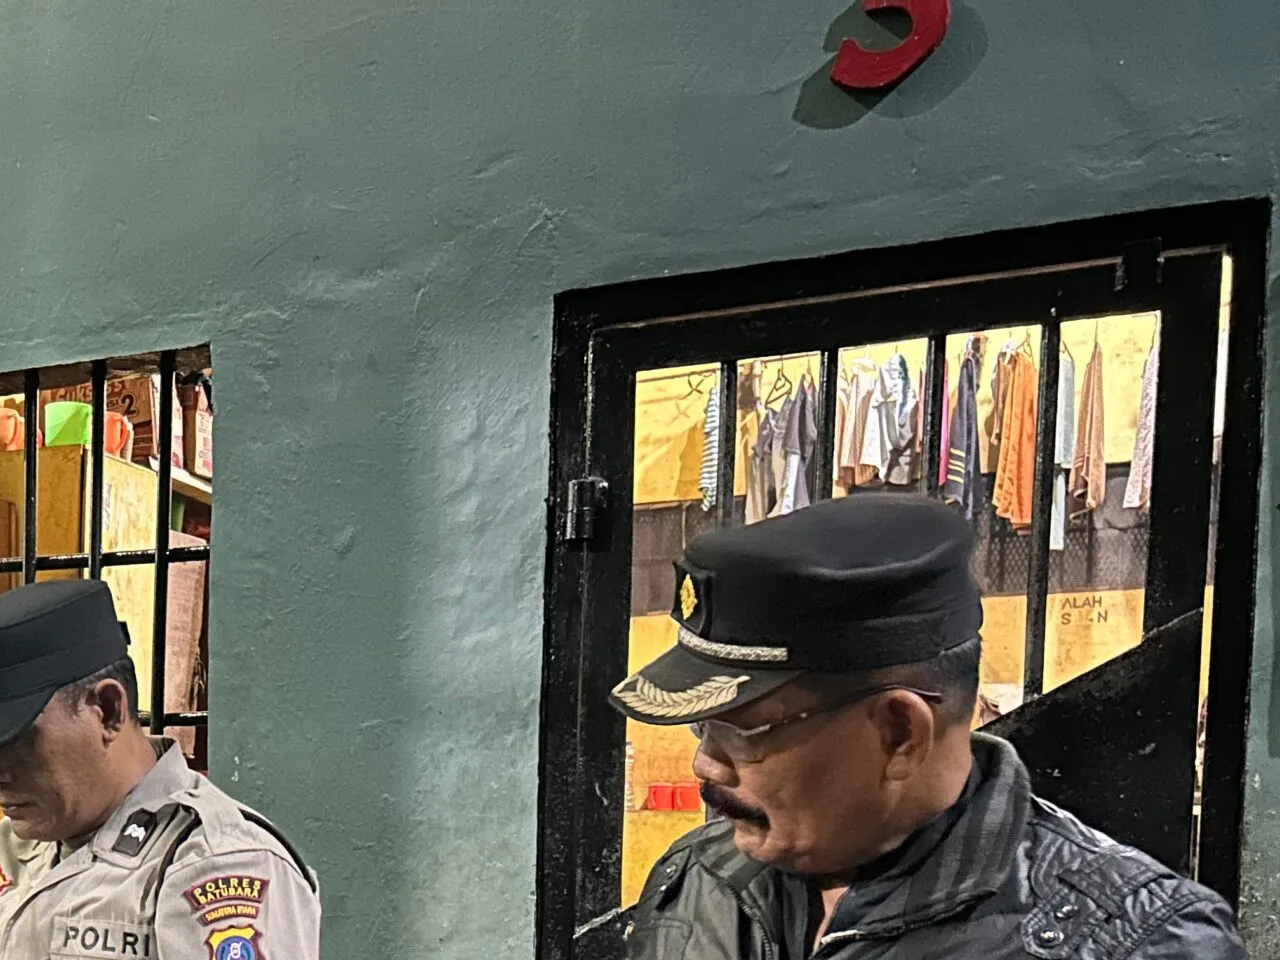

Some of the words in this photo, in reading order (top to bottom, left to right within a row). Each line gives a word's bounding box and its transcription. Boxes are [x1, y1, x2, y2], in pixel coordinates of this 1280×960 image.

[122, 394, 136, 416] 2
[193, 878, 261, 897] POLRES
[63, 926, 150, 957] POLRI
